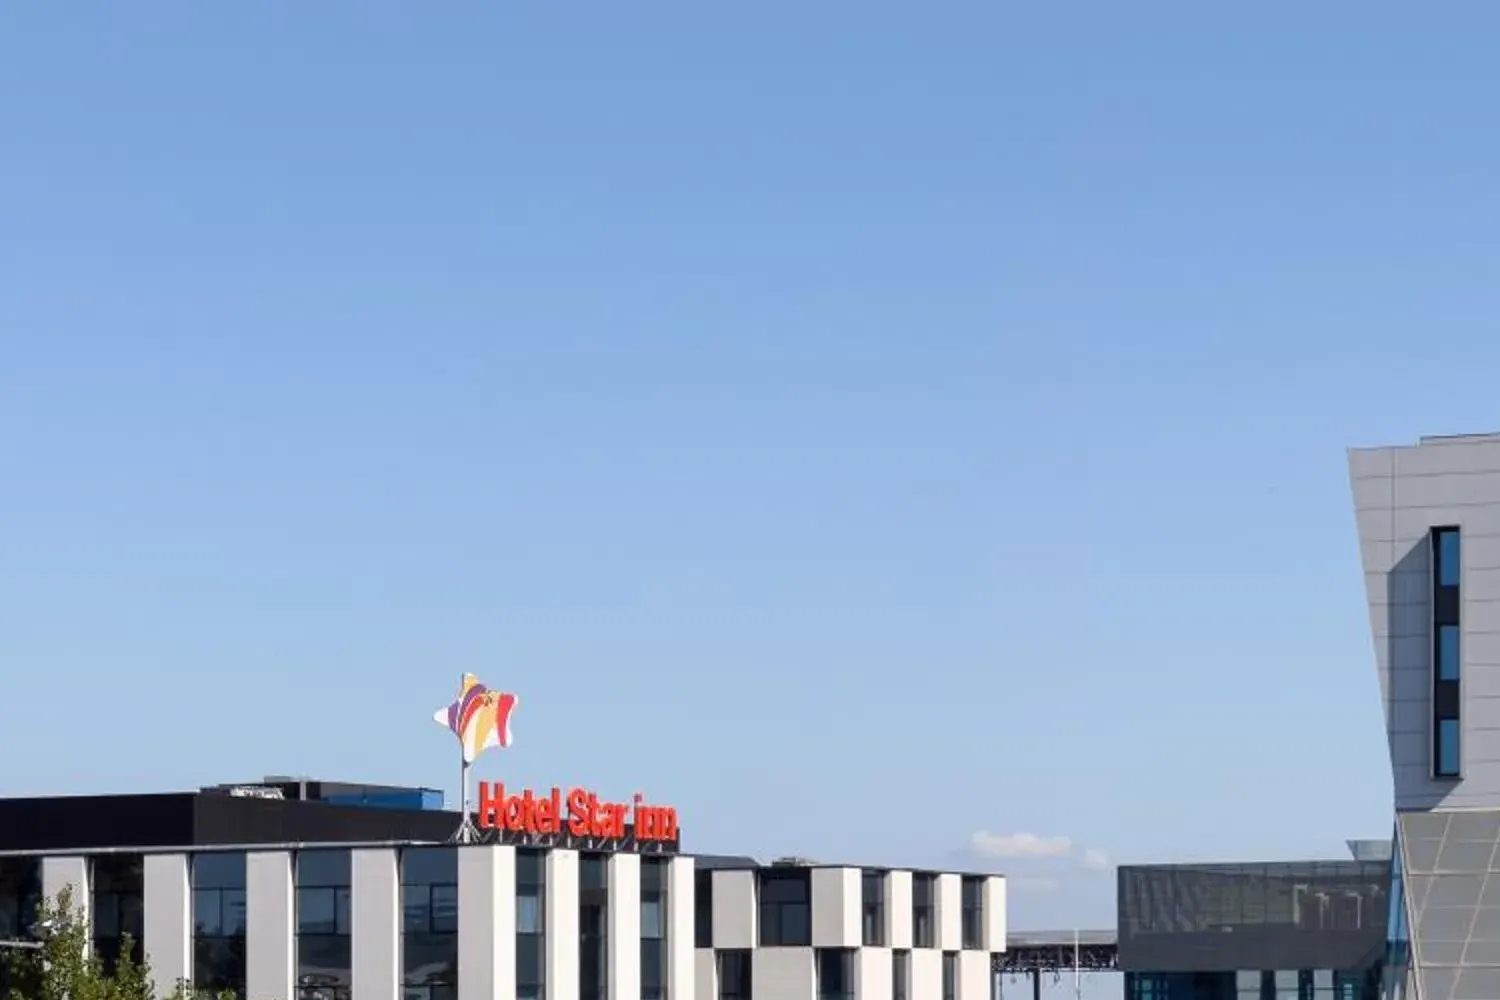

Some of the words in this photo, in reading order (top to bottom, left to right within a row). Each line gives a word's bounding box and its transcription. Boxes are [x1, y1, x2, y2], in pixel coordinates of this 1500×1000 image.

[478, 781, 560, 833] Hotel
[567, 787, 627, 840] Star
[633, 793, 677, 841] inn
